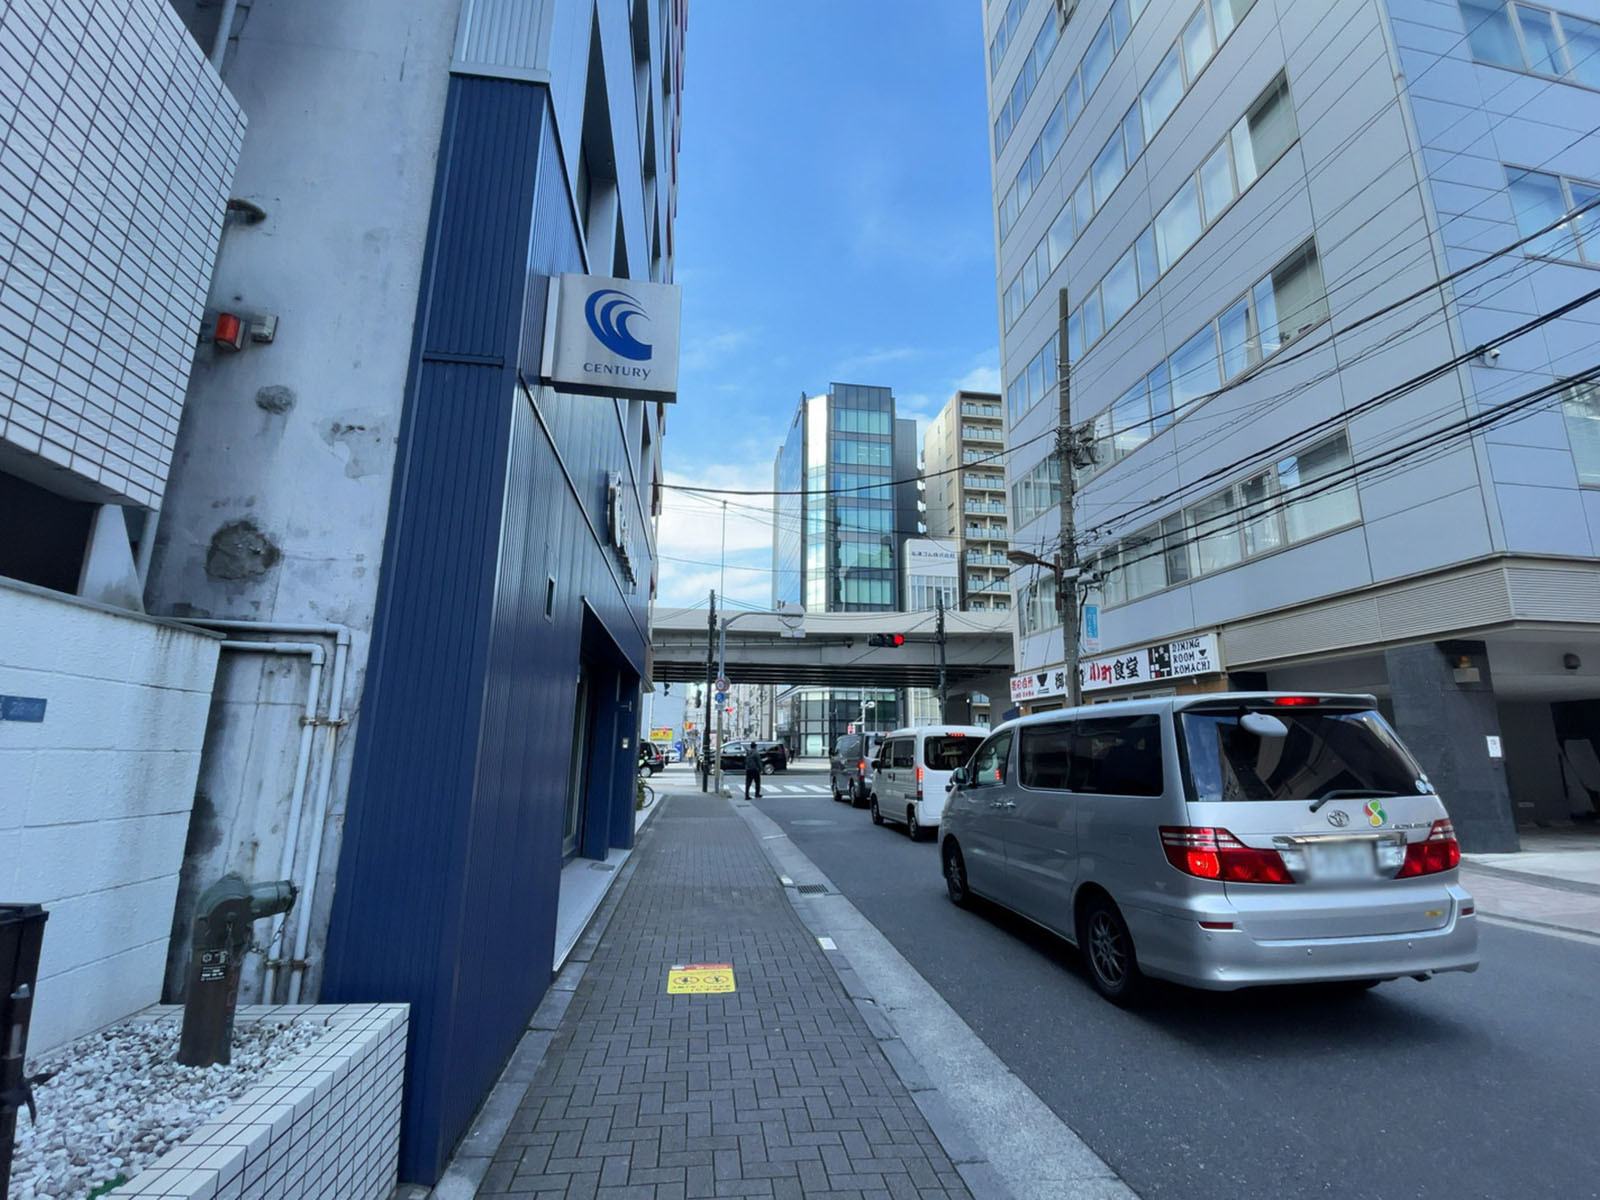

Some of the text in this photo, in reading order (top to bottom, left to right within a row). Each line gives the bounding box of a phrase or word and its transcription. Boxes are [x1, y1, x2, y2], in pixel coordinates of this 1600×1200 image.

[583, 362, 652, 381] CENTURY
[1172, 638, 1200, 653] DINING
[1172, 651, 1196, 664] ROOM
[1173, 660, 1211, 676] KOMACHI
